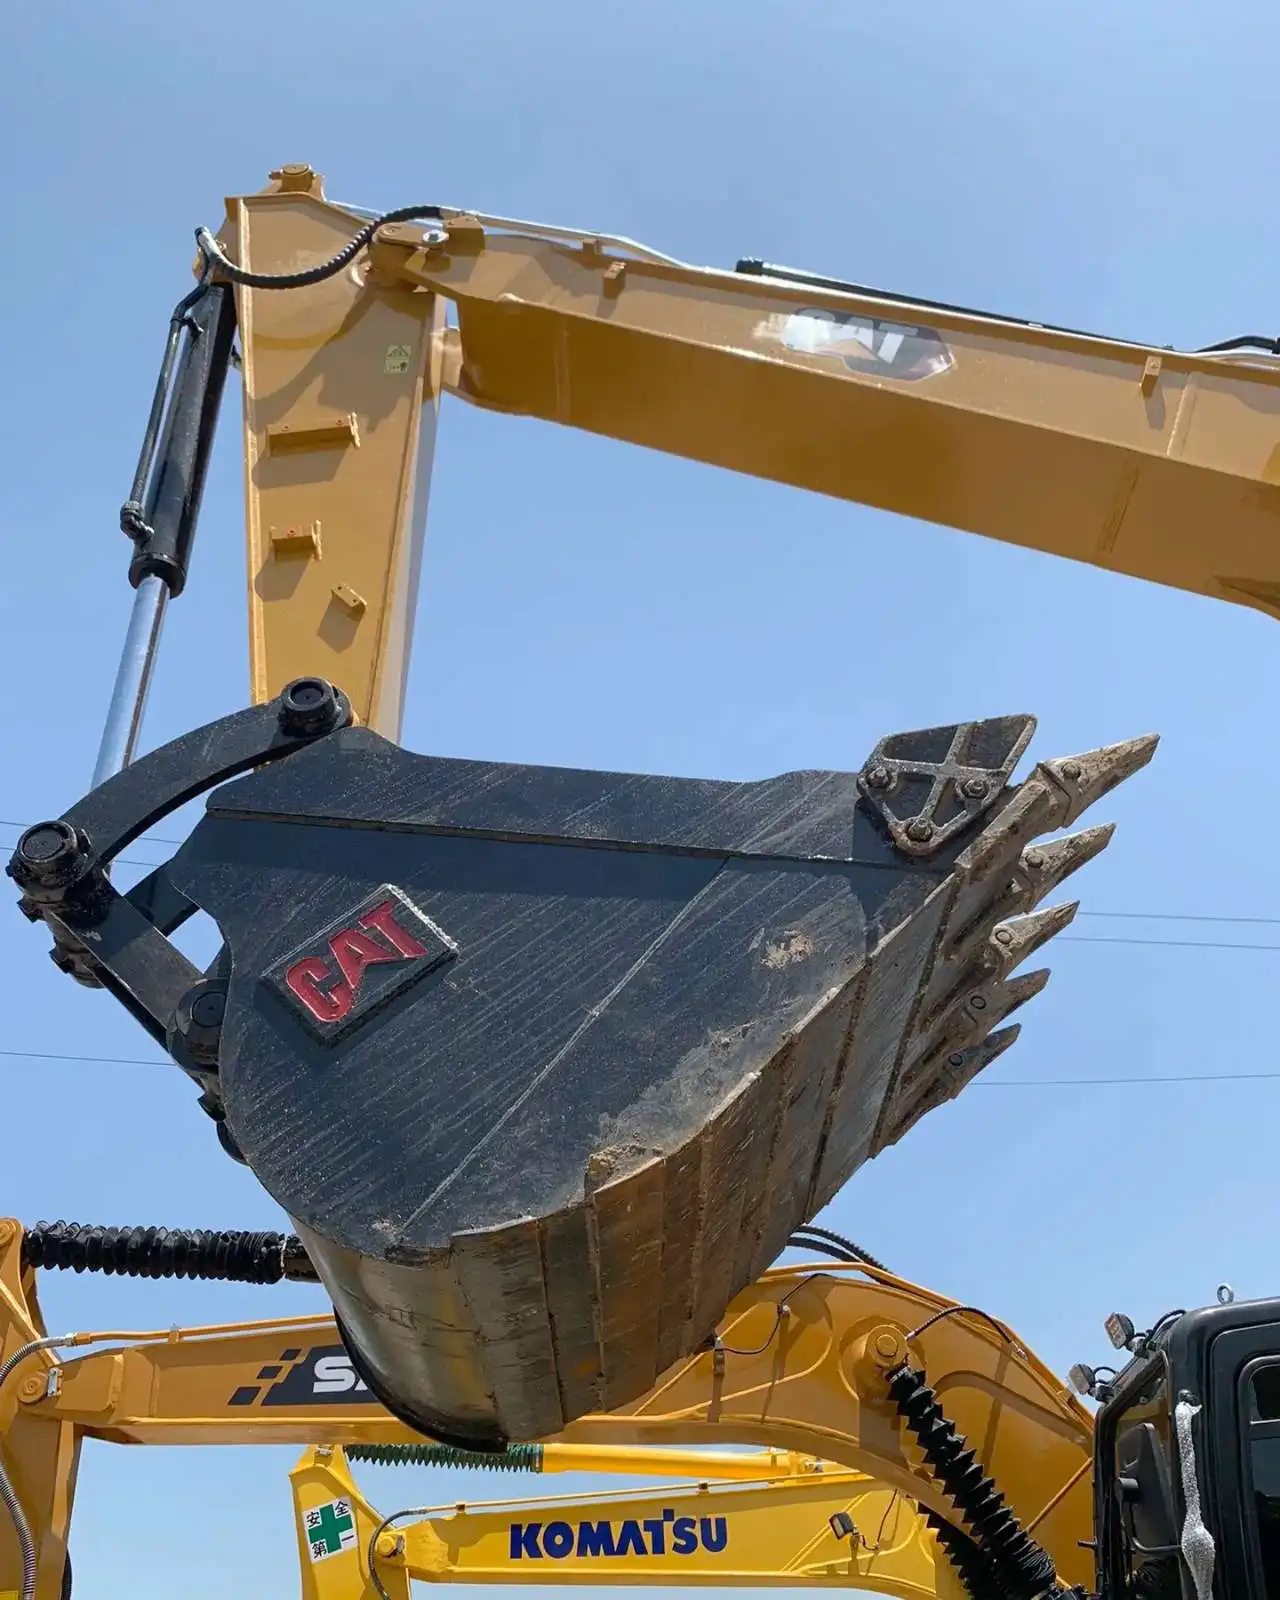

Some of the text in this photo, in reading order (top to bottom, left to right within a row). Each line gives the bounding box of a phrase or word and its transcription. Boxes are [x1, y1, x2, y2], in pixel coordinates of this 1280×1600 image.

[286, 901, 428, 1022] CAT
[313, 1356, 369, 1392] S
[510, 1509, 728, 1559] KOMATSU
